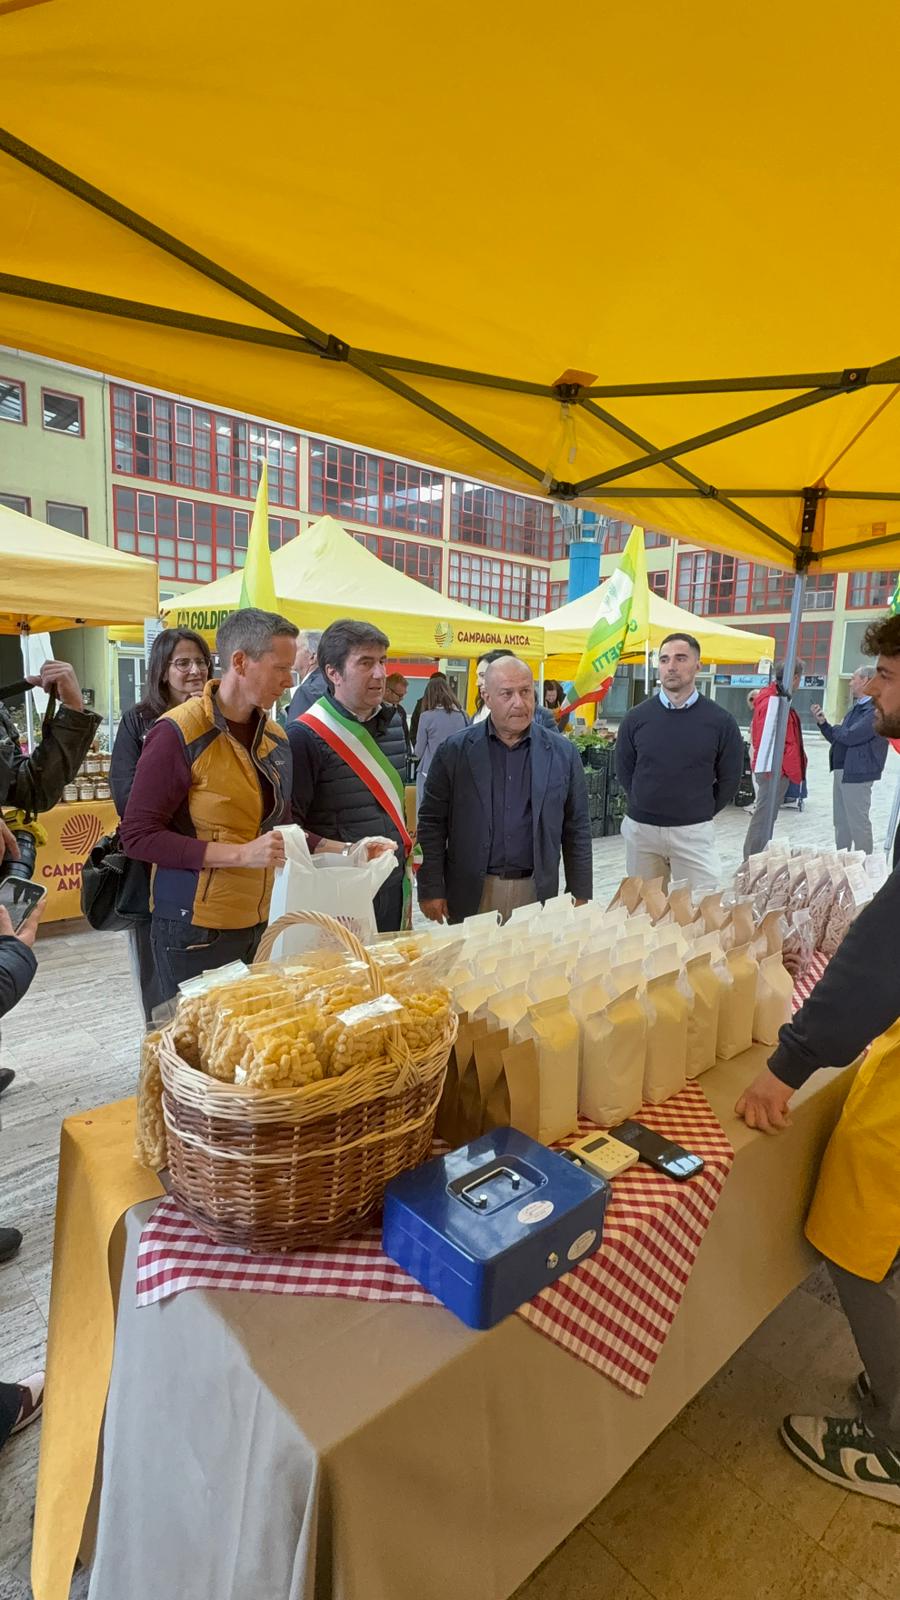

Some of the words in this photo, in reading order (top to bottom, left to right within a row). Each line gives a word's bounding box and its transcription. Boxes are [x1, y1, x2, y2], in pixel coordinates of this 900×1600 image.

[190, 609, 235, 630] COLDIR
[457, 631, 501, 644] CAMPAGNA
[504, 634, 530, 646] AMICA
[42, 862, 84, 878] CAMP
[57, 877, 81, 891] AM
